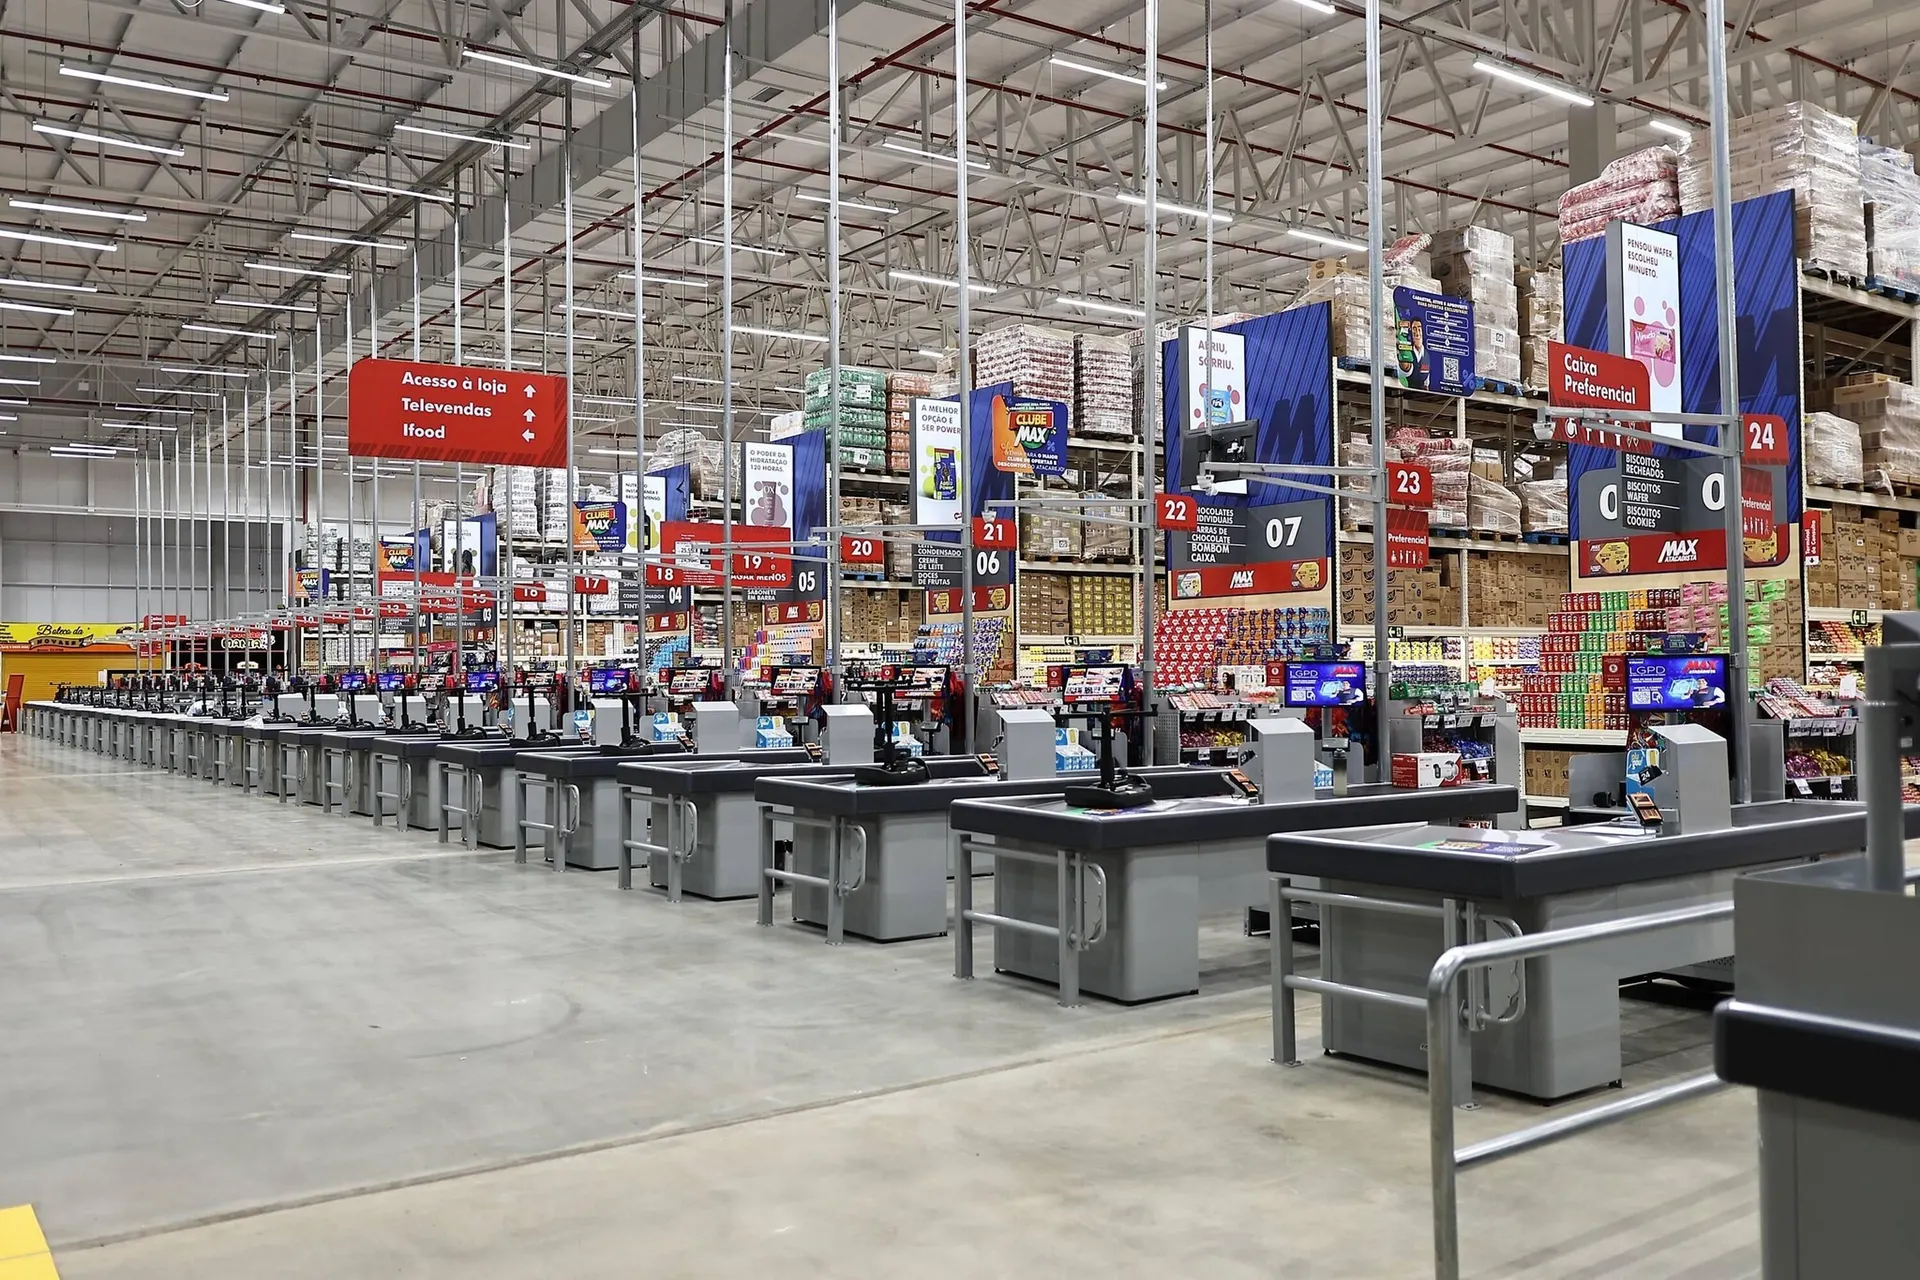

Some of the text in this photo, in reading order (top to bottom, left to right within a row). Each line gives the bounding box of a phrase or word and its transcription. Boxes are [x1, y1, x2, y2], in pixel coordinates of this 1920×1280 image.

[1628, 238, 1652, 253] PENSOU
[1628, 251, 1658, 266] ESCOLHEU
[1564, 353, 1597, 376] Caixa
[402, 371, 507, 395] Acesso à loja
[1564, 374, 1636, 404] Preferencial
[401, 397, 492, 417] Televendas
[928, 405, 958, 414] MELHOR
[1016, 414, 1047, 425] CLUBE
[403, 423, 445, 439] Ifood
[1014, 426, 1048, 447] MAX
[1749, 422, 1775, 450] 24
[756, 450, 777, 458] PODER
[1626, 454, 1660, 468] BISCOITOS
[1626, 464, 1664, 479] RECHEADOS
[1397, 470, 1420, 495] 23
[1627, 481, 1661, 494] BISCOITOS
[1627, 491, 1649, 502] WAFER
[585, 510, 610, 520] CLUBE
[1165, 500, 1187, 520] 22
[1627, 505, 1661, 519] BISCOITOS
[584, 520, 611, 534] MAX
[1627, 516, 1655, 528] COOKIES
[983, 523, 1003, 541] 21
[1196, 526, 1228, 535] ARRAS DE
[1266, 516, 1302, 548] 07
[1191, 533, 1231, 544] CHOCOLATE
[1387, 533, 1427, 545] Preferencial
[851, 540, 873, 556] 20
[917, 548, 962, 557] CONDENSADO
[1191, 543, 1230, 553] BOMBOM
[1658, 539, 1699, 563] MAX
[743, 555, 762, 569] 19
[976, 550, 1000, 576] 06
[1191, 553, 1216, 563] CAIXA
[656, 567, 674, 581] 18
[1230, 570, 1255, 588] MAX
[584, 577, 600, 588] 17
[799, 571, 816, 592] 05
[669, 586, 682, 604] 04
[482, 608, 492, 621] 03
[1629, 666, 1665, 674] LGPD
[1640, 771, 1651, 781] 24
